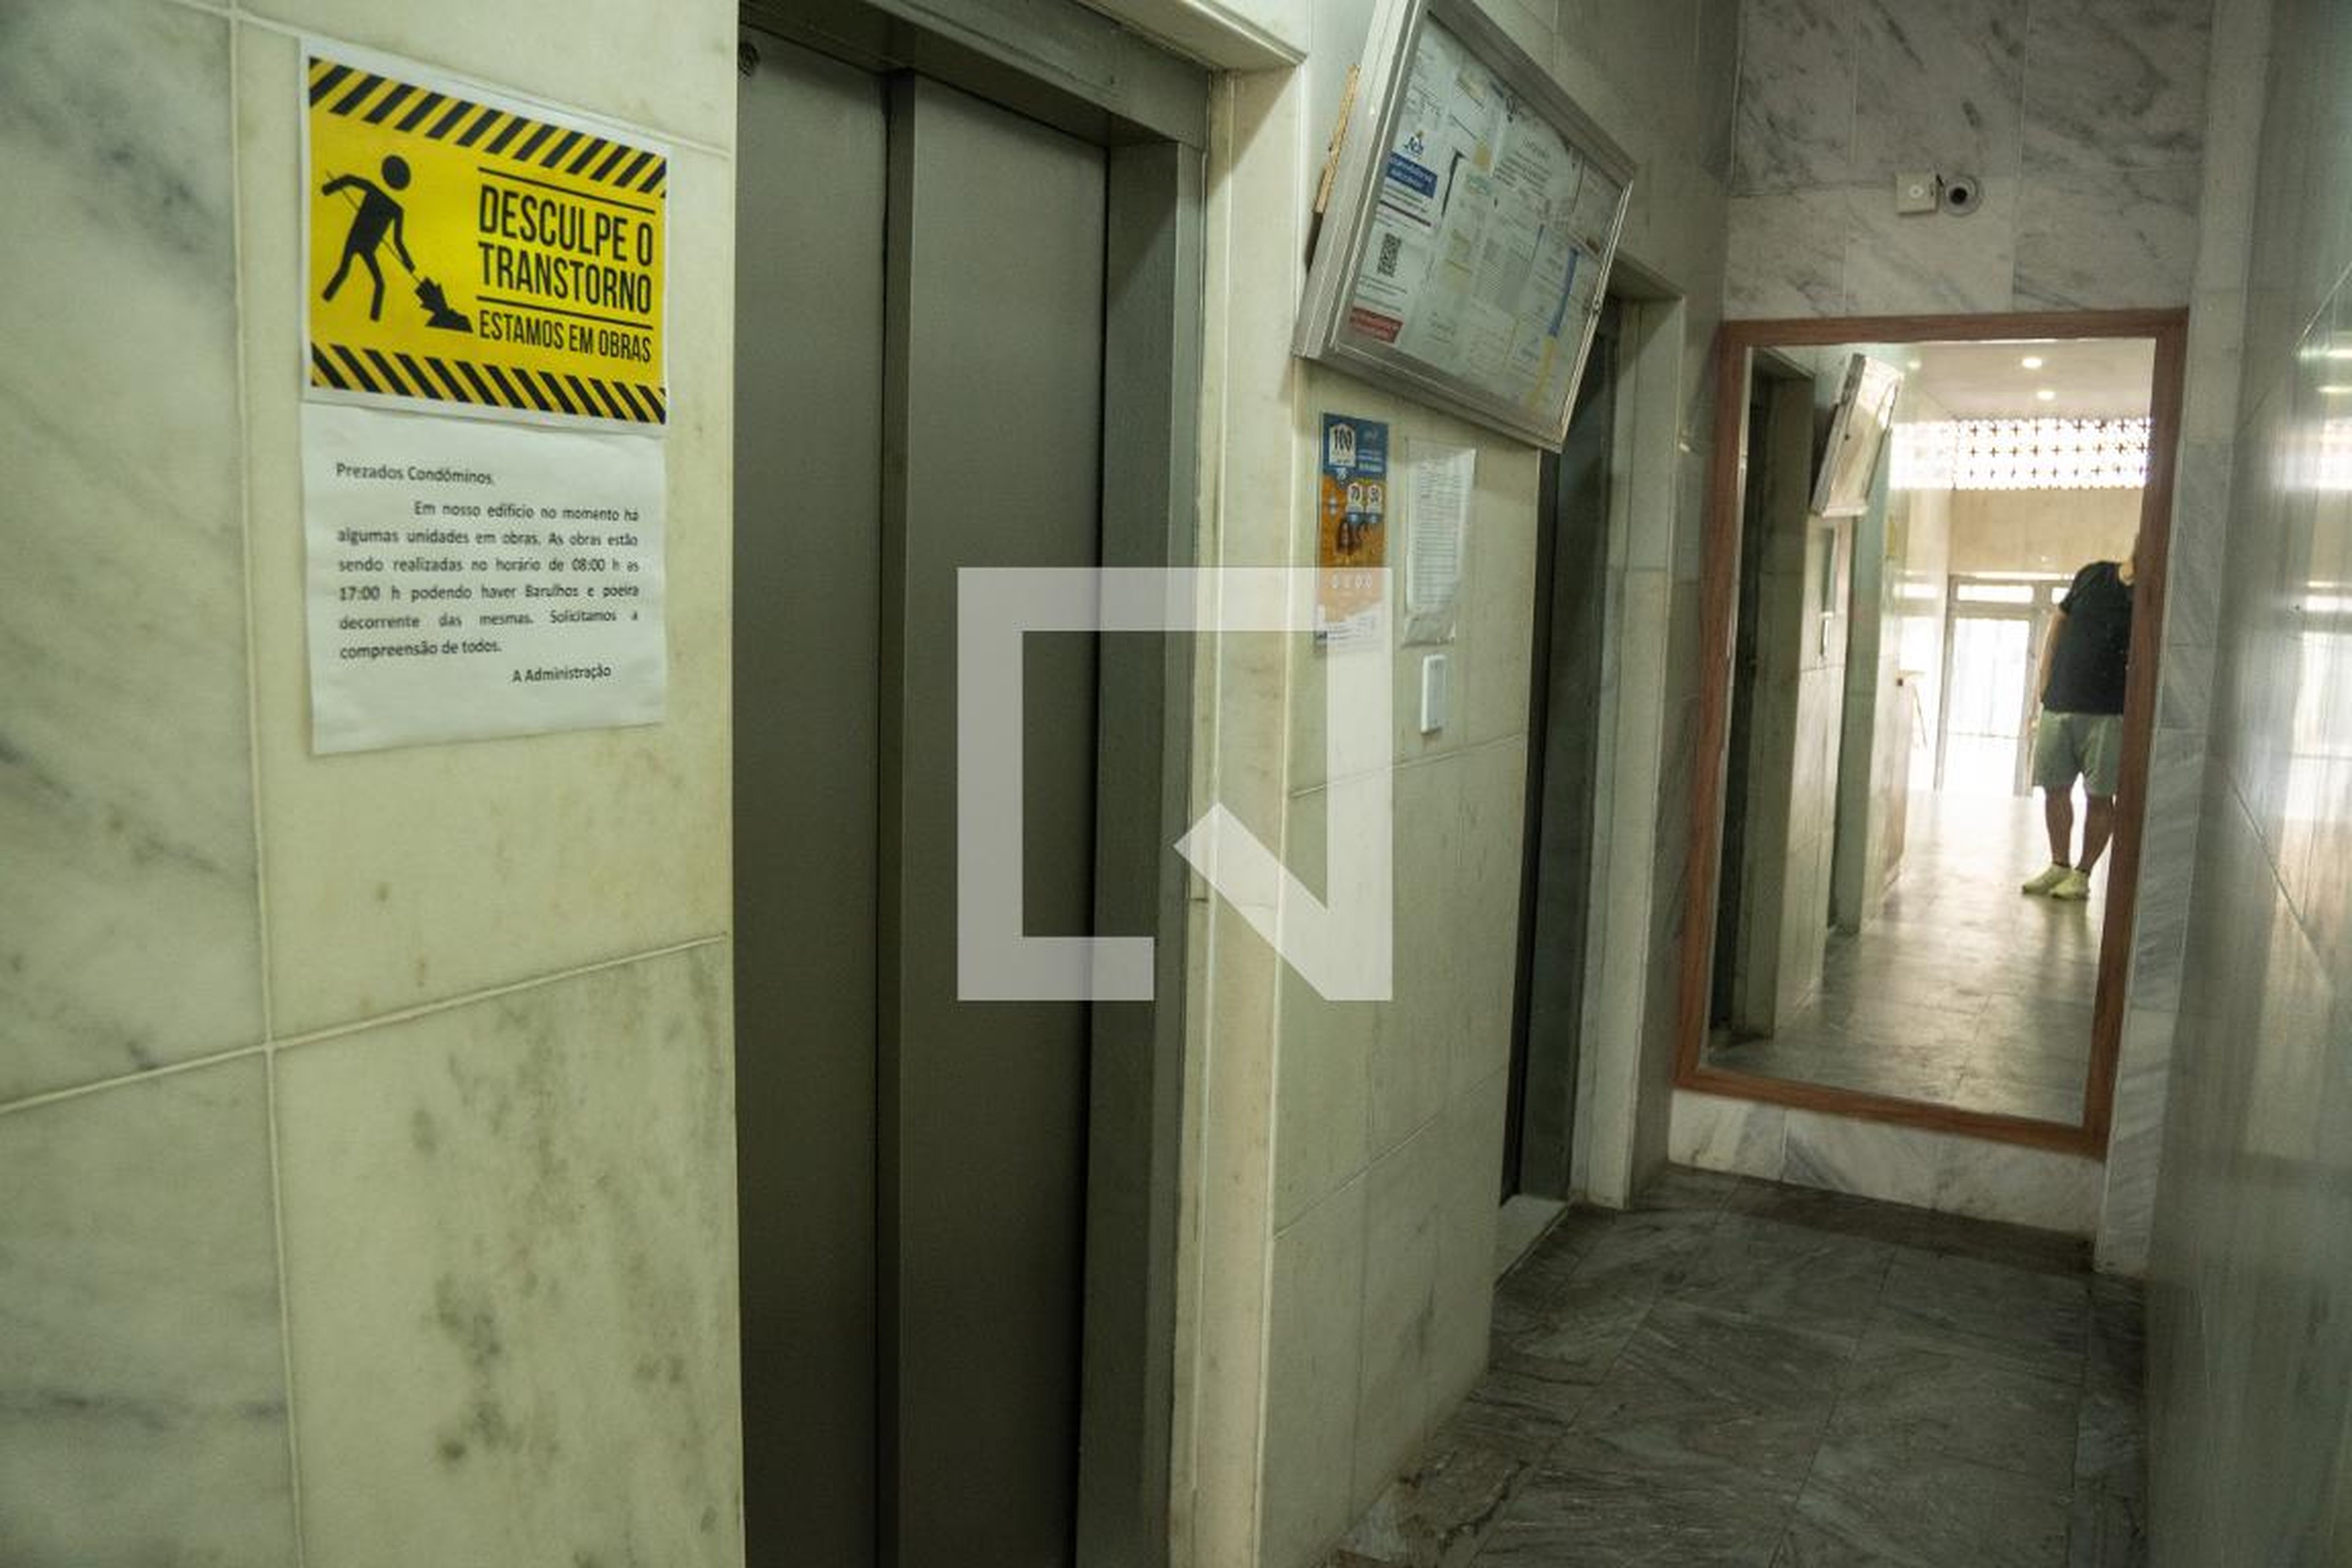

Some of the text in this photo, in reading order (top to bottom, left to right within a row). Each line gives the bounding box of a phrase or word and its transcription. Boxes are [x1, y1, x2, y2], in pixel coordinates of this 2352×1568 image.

[479, 184, 653, 266] DESCULPE O
[478, 241, 652, 315] TRANSTORNO
[480, 309, 652, 363] ESTAMOS EM OBRAS
[337, 462, 404, 480] Prezados
[414, 500, 436, 516] Em
[442, 505, 481, 517] nosso
[541, 507, 557, 519] no
[562, 510, 620, 521] momento
[337, 527, 399, 546] algumas
[407, 527, 469, 545] unidades
[476, 532, 497, 545] em
[569, 532, 601, 546] obras
[608, 533, 639, 546] estão
[338, 556, 385, 572] sendo
[393, 556, 464, 573] realizadas
[471, 560, 488, 572] no
[548, 558, 565, 573] de
[571, 557, 606, 573] 08:00
[612, 559, 620, 572] h
[339, 584, 639, 603] 17:00 h podendo haver Barulhos e poeira
[339, 613, 420, 630] decorrente
[438, 612, 462, 628] das
[549, 609, 617, 624] Solicitamos
[339, 639, 439, 660] compreensão
[442, 641, 458, 655] de
[512, 662, 612, 682] A Administração
